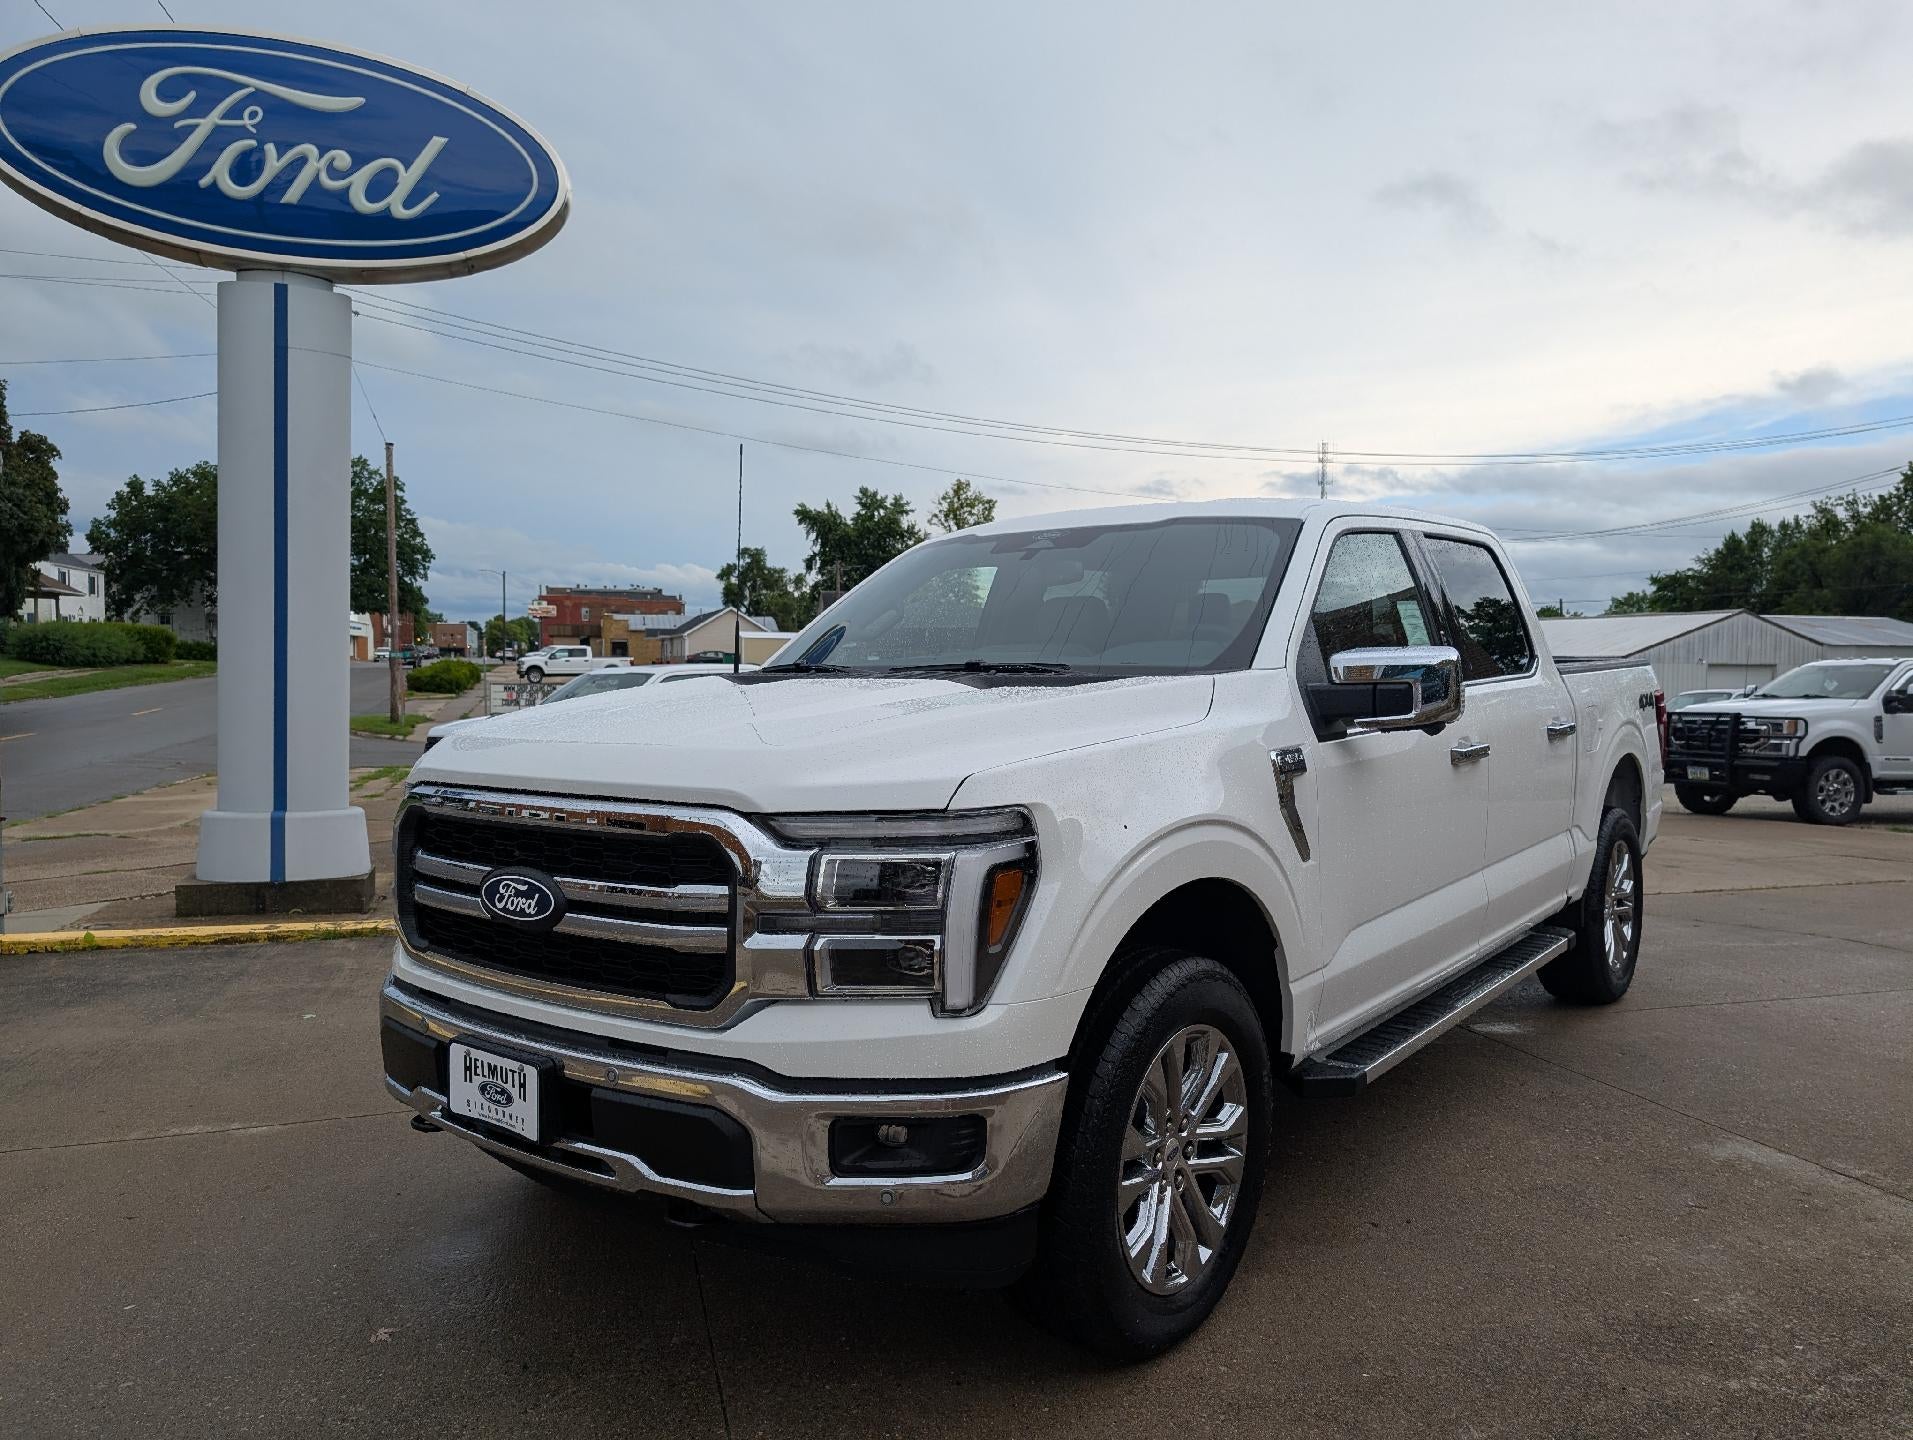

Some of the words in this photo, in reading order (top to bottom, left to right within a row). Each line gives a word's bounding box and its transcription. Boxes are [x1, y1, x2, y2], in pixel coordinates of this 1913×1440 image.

[103, 66, 449, 220] Ford
[495, 881, 539, 914] Ford
[464, 1055, 527, 1103] HELMUTH
[484, 1085, 507, 1104] Ford
